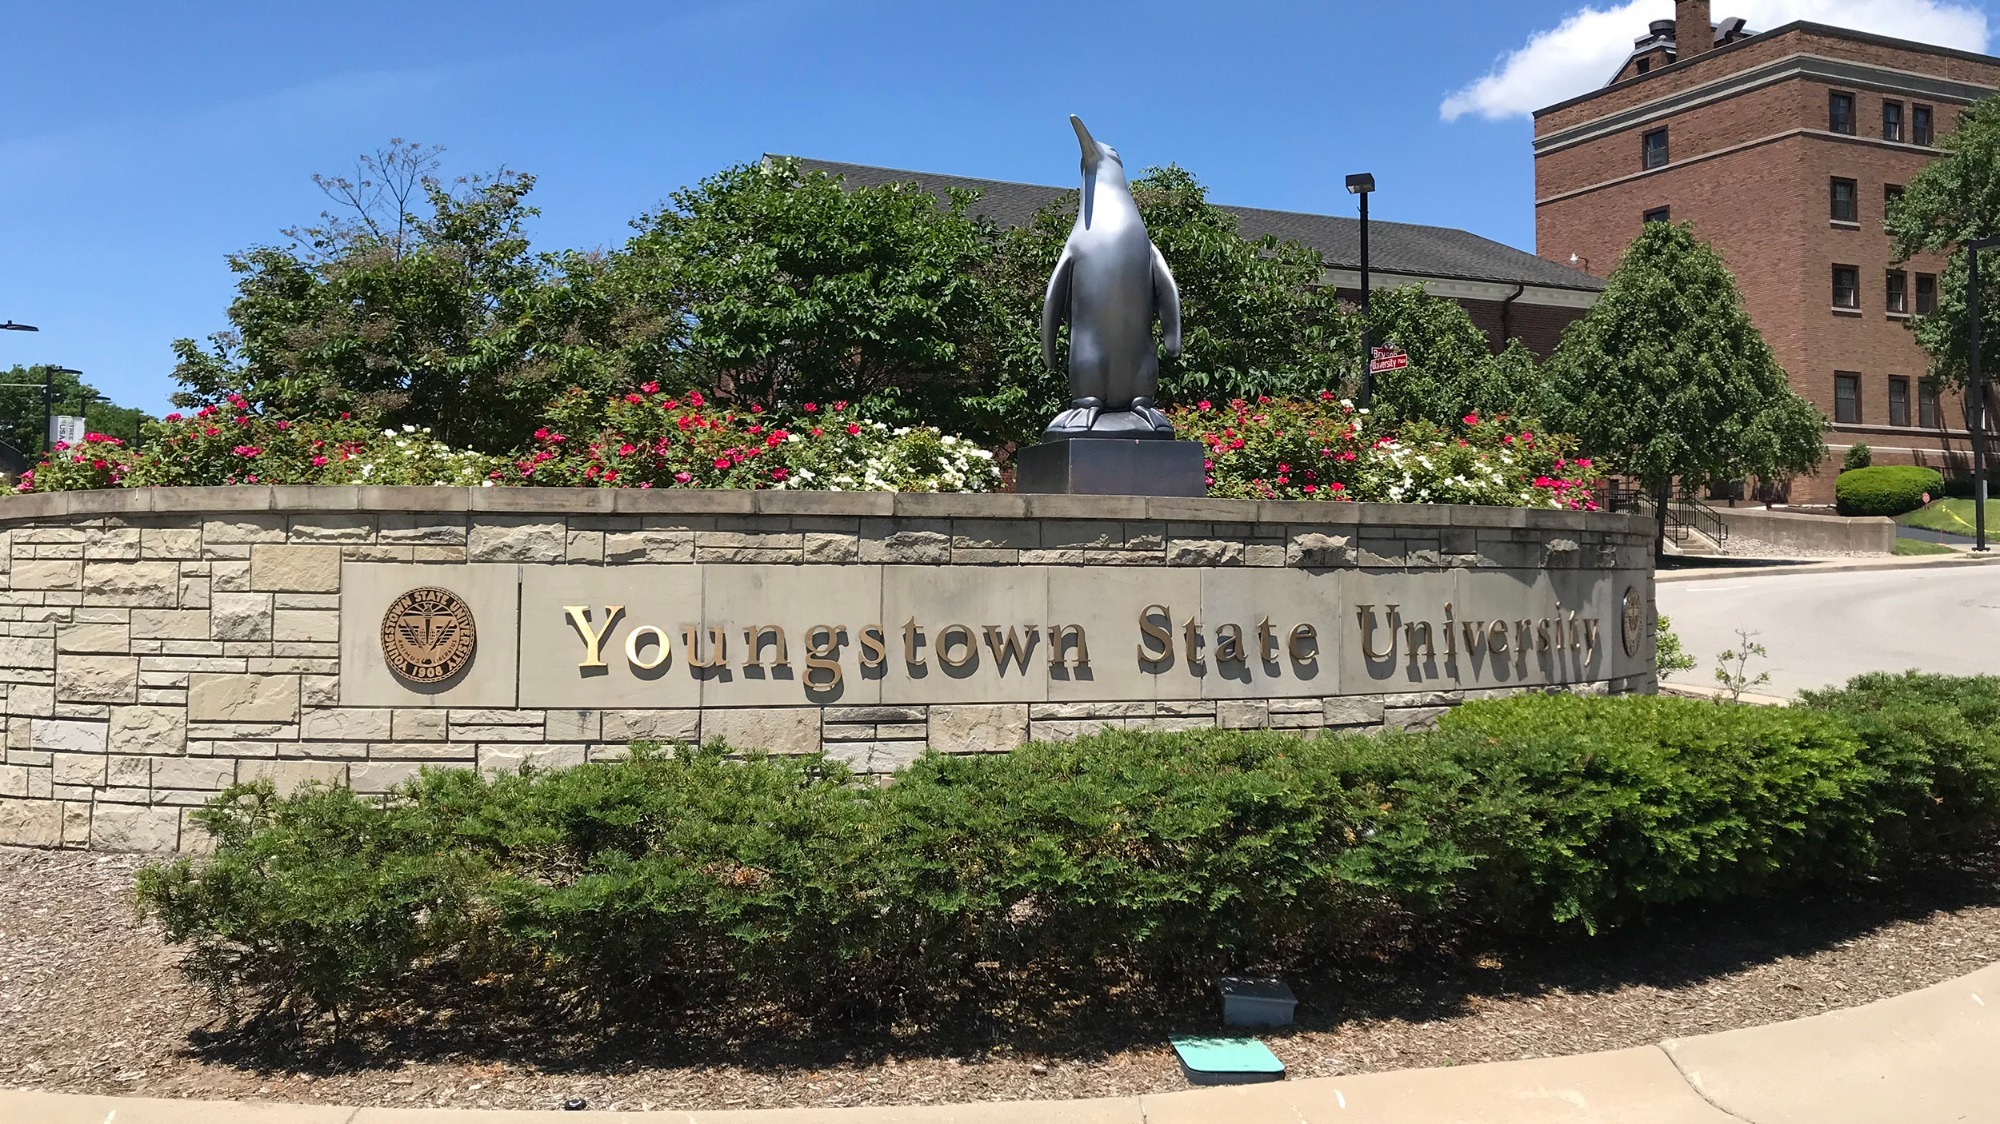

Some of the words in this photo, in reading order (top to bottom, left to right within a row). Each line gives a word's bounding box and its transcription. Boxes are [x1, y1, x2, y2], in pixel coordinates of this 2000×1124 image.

[384, 596, 412, 671] YOUNGSTOWN
[413, 590, 450, 605] STATE
[446, 601, 471, 671] UNIVERSITY
[562, 605, 1092, 690] Youngstown
[1137, 603, 1319, 664] State
[1356, 601, 1600, 667] University
[411, 665, 443, 678] 1908
